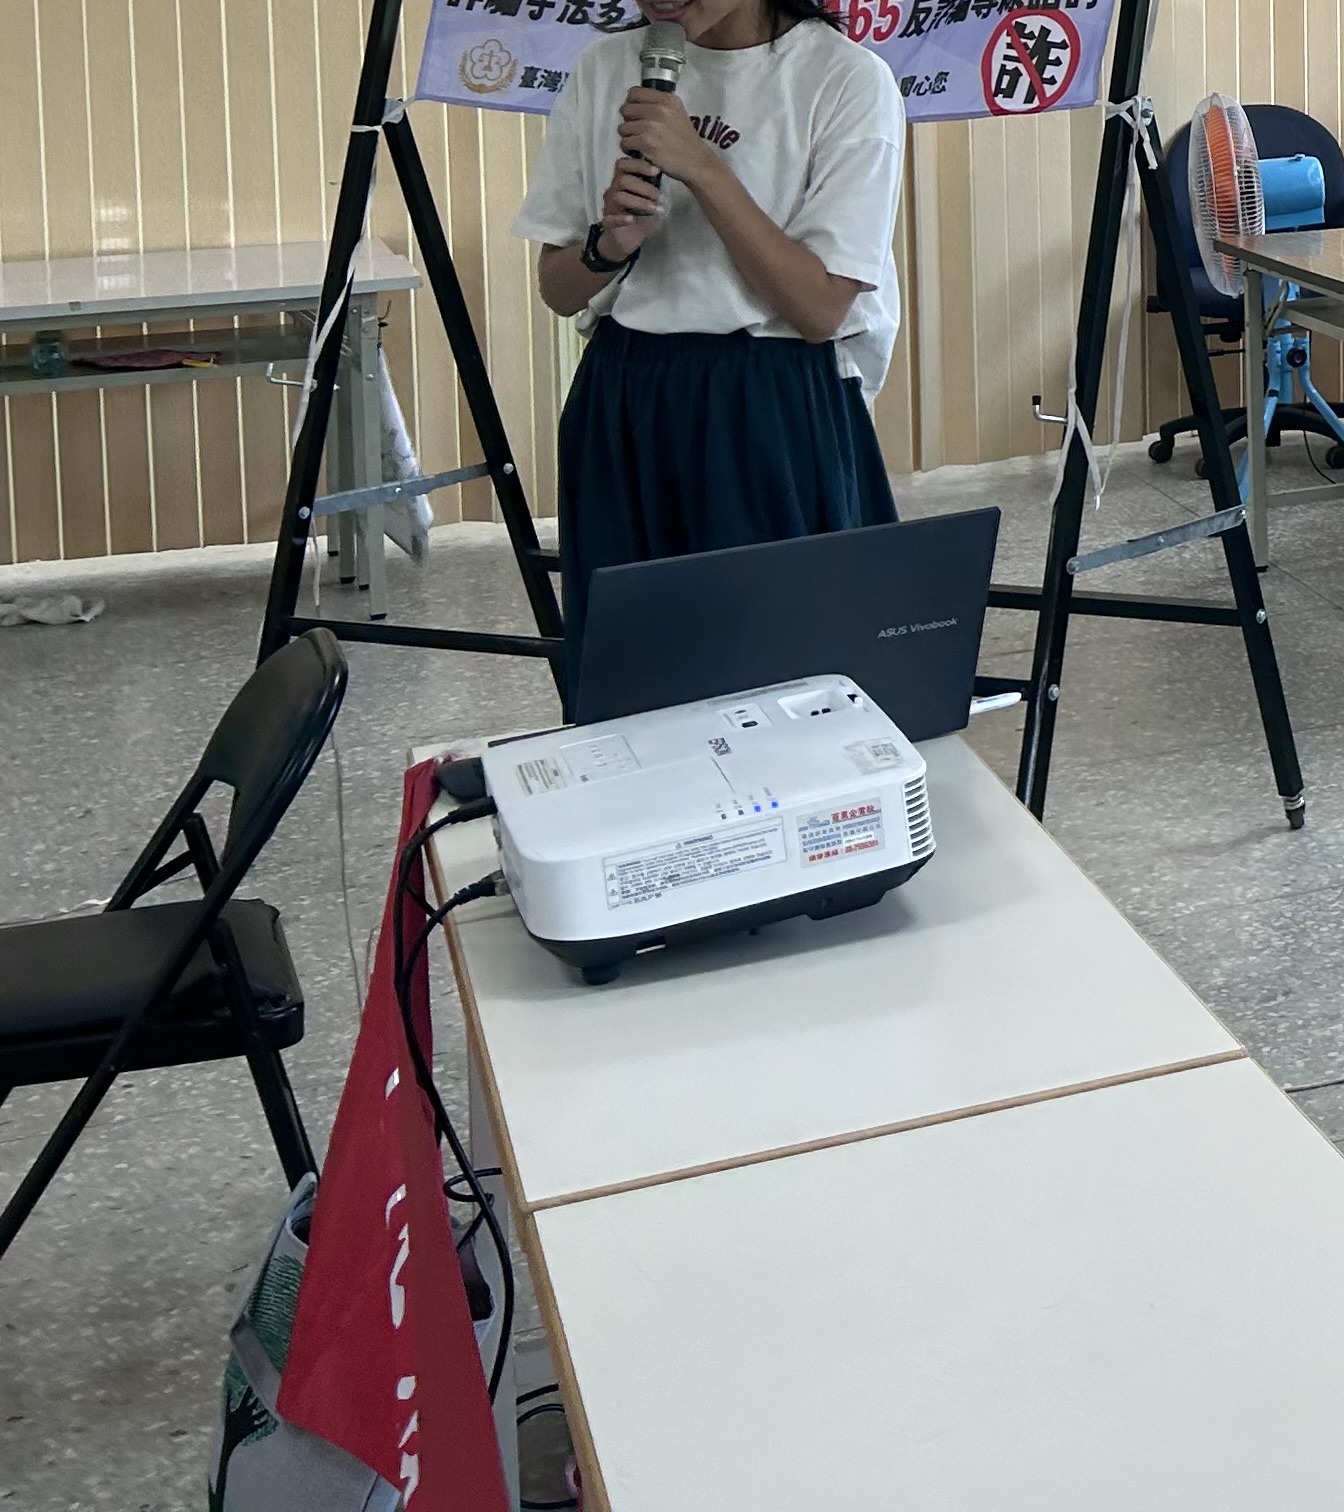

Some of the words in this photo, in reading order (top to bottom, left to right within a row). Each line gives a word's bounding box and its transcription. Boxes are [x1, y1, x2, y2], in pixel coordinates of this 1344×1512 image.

[518, 66, 569, 93] 臺灣
[877, 625, 907, 638] ASUS
[910, 617, 959, 633] Vivobook
